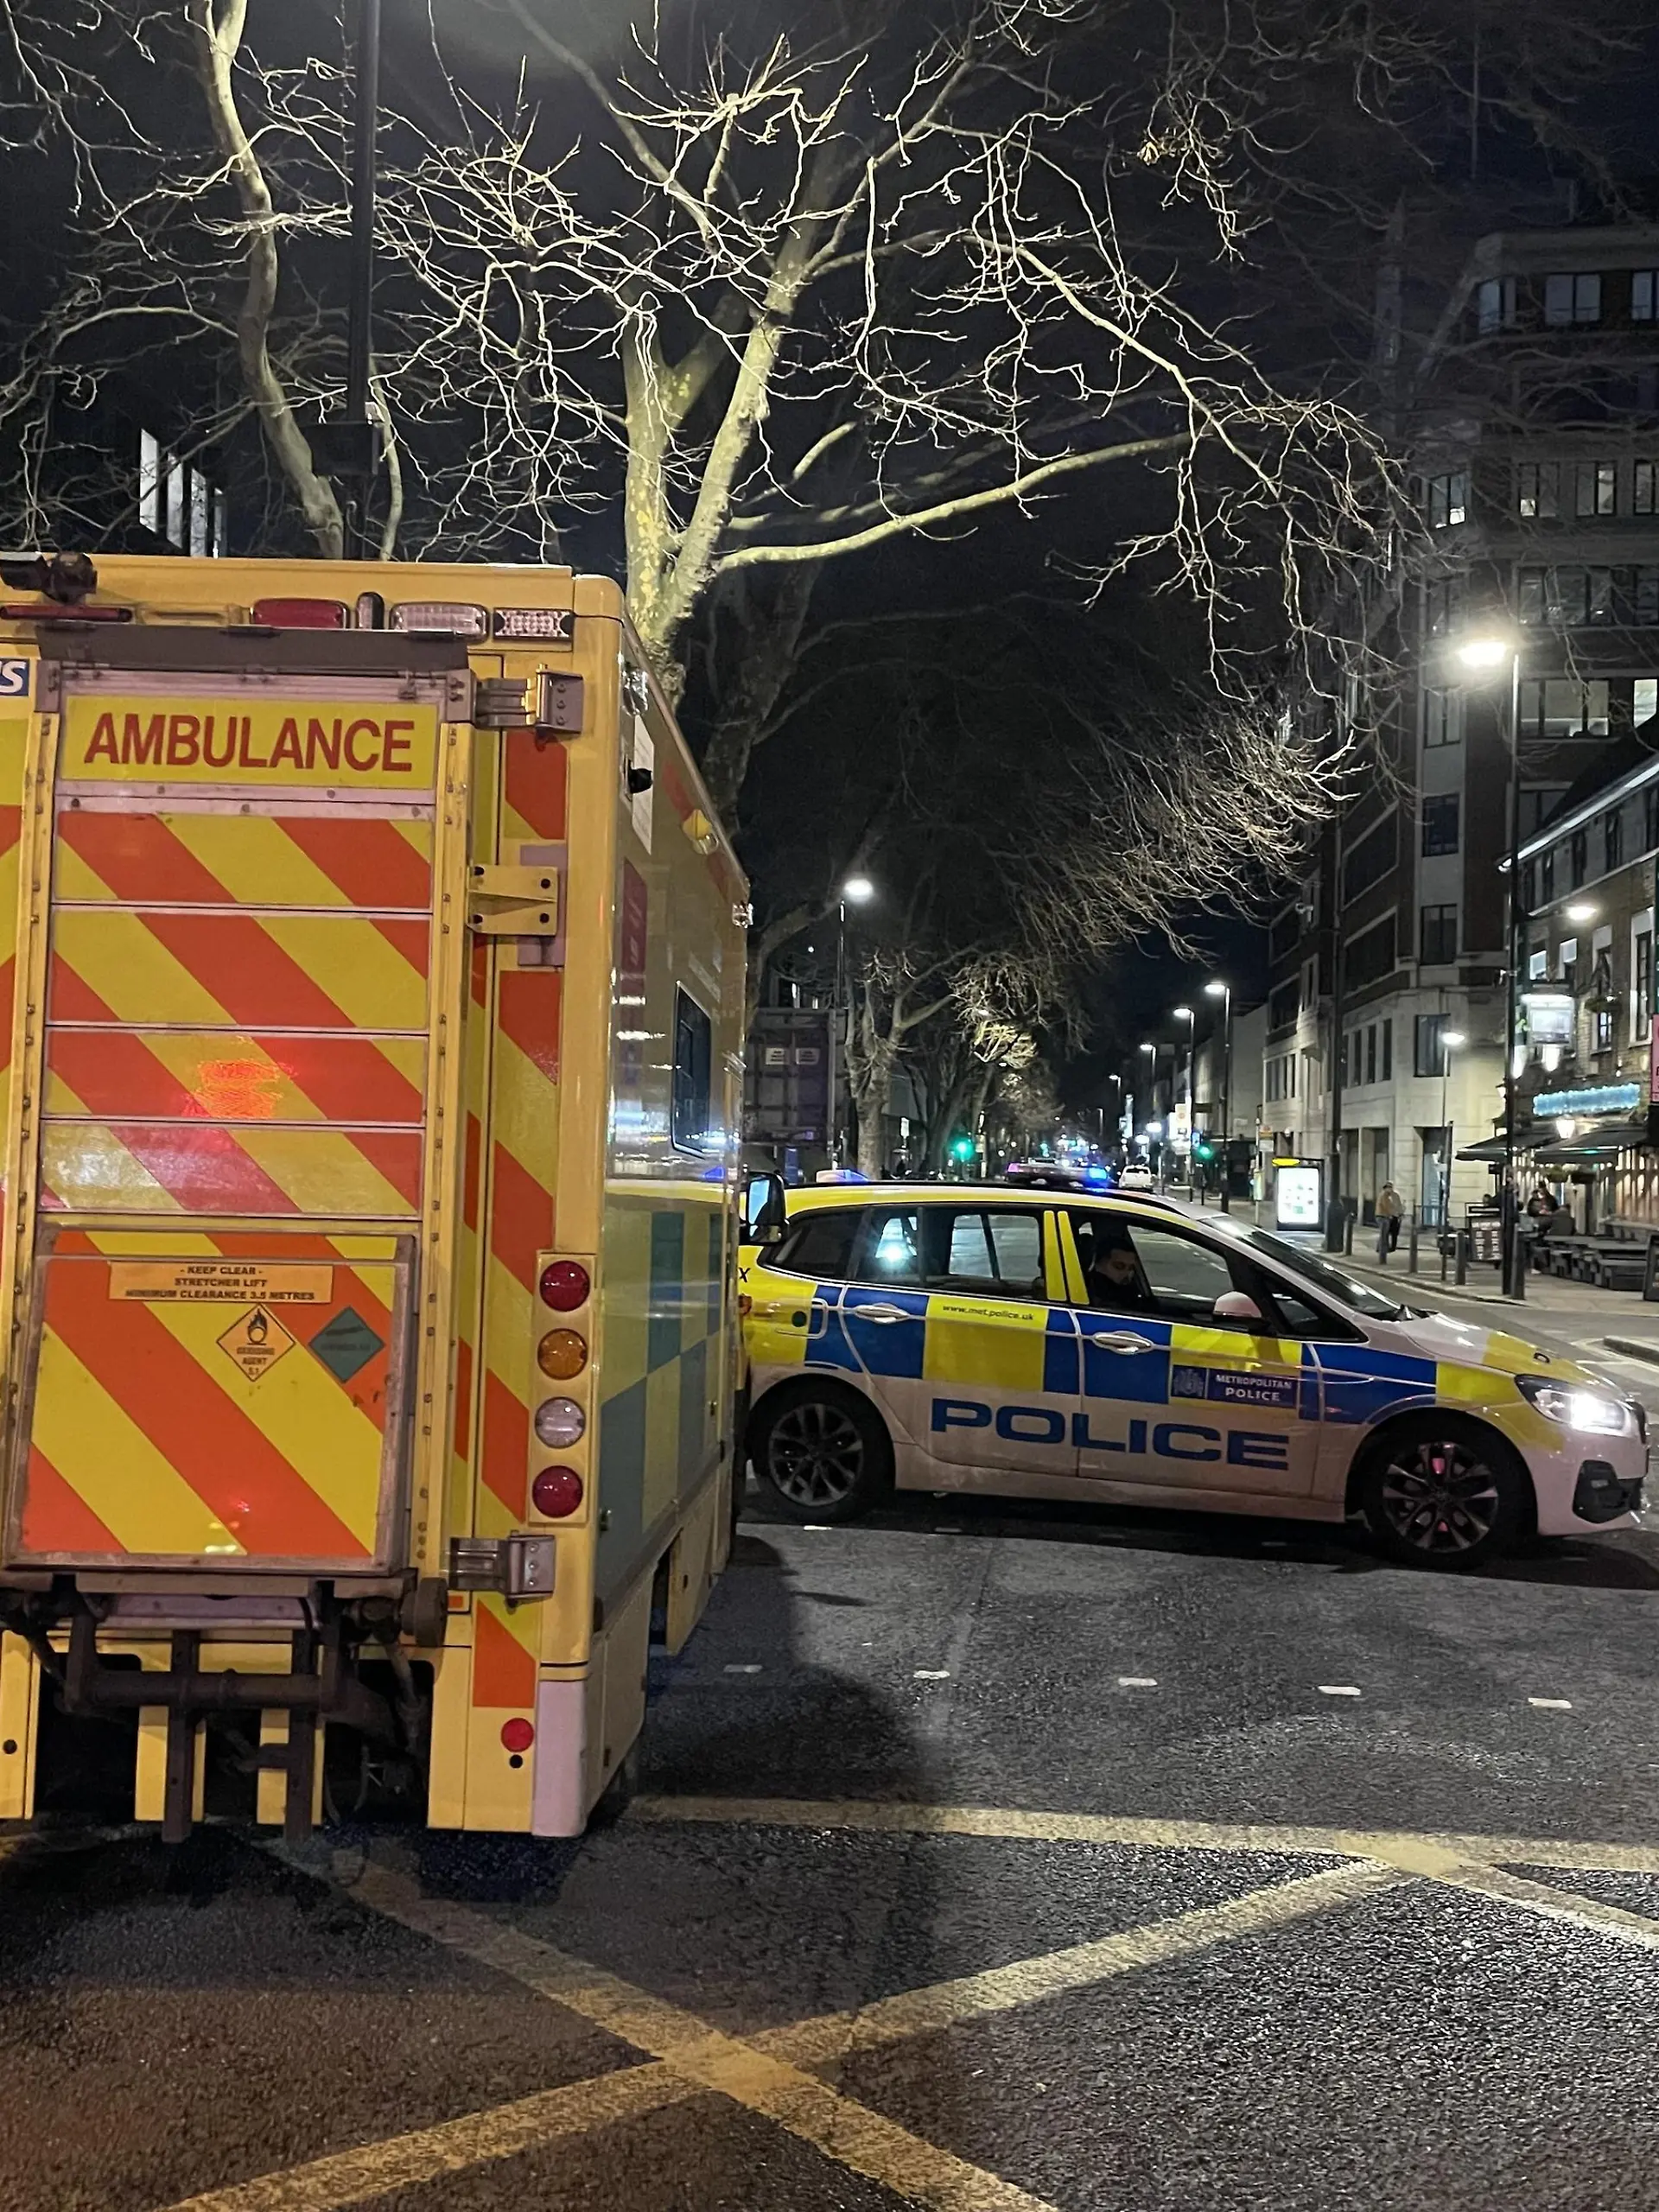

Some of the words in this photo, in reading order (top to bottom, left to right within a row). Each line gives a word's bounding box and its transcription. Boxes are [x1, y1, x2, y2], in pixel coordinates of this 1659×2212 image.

[0, 661, 26, 693] S
[84, 712, 415, 772] AMBULANCE
[175, 1278, 240, 1287] STRETCHER
[243, 1279, 267, 1287] LIFT
[180, 1290, 246, 1300] CLEARANCE
[250, 1291, 266, 1300] 3.5
[269, 1292, 315, 1300] METRES
[943, 1306, 1033, 1320] www.met.police.uk
[1216, 1374, 1292, 1389] METROPOLITAN
[1225, 1387, 1281, 1402] POLICE
[931, 1397, 1289, 1471] POLICE
